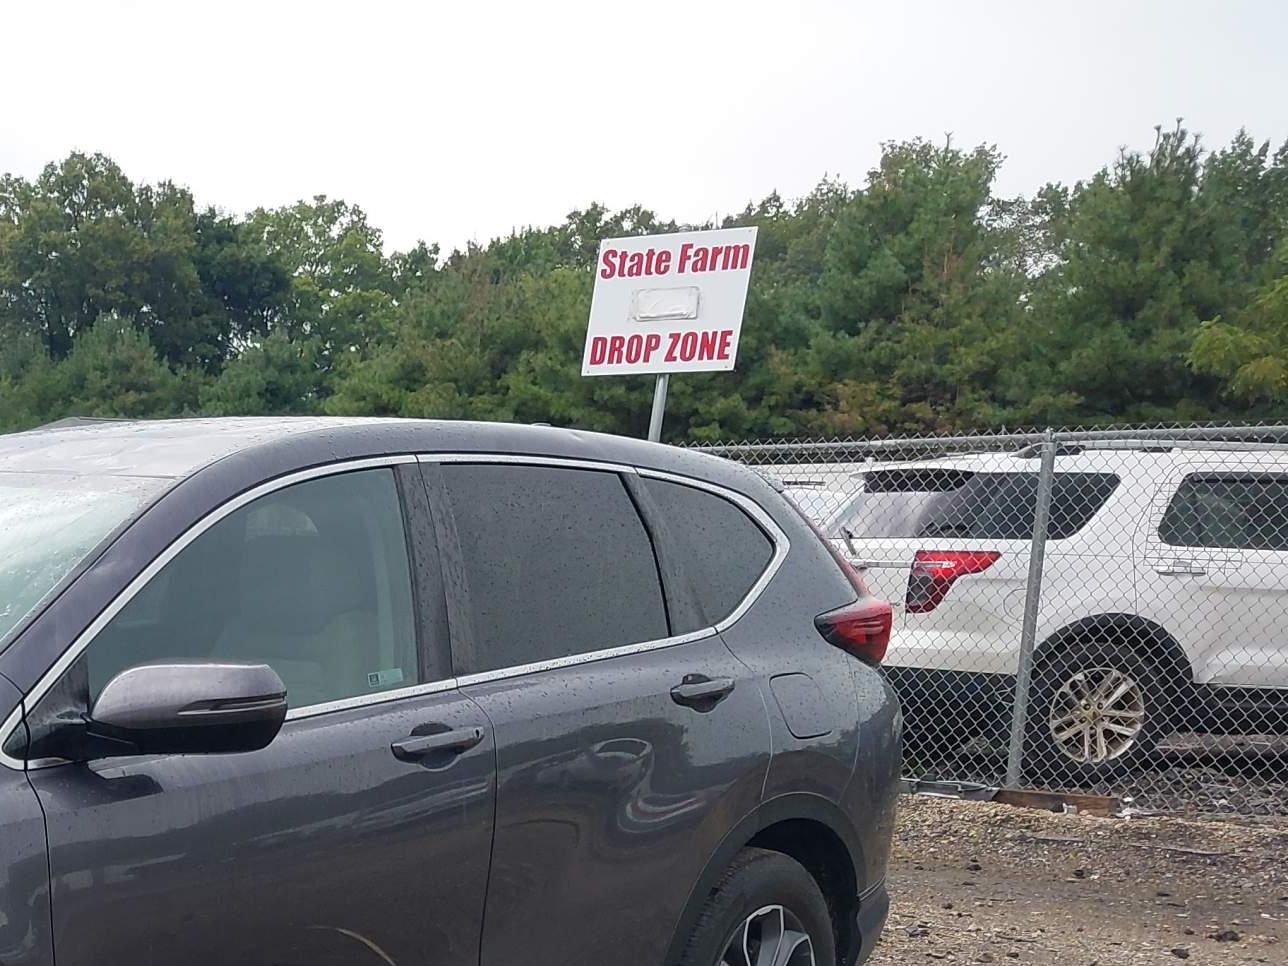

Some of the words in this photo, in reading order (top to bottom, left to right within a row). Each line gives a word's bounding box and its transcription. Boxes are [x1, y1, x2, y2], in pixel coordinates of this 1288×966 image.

[600, 248, 672, 280] State
[677, 243, 751, 274] Farm
[589, 333, 662, 366] DROP
[663, 329, 734, 363] ZONE
